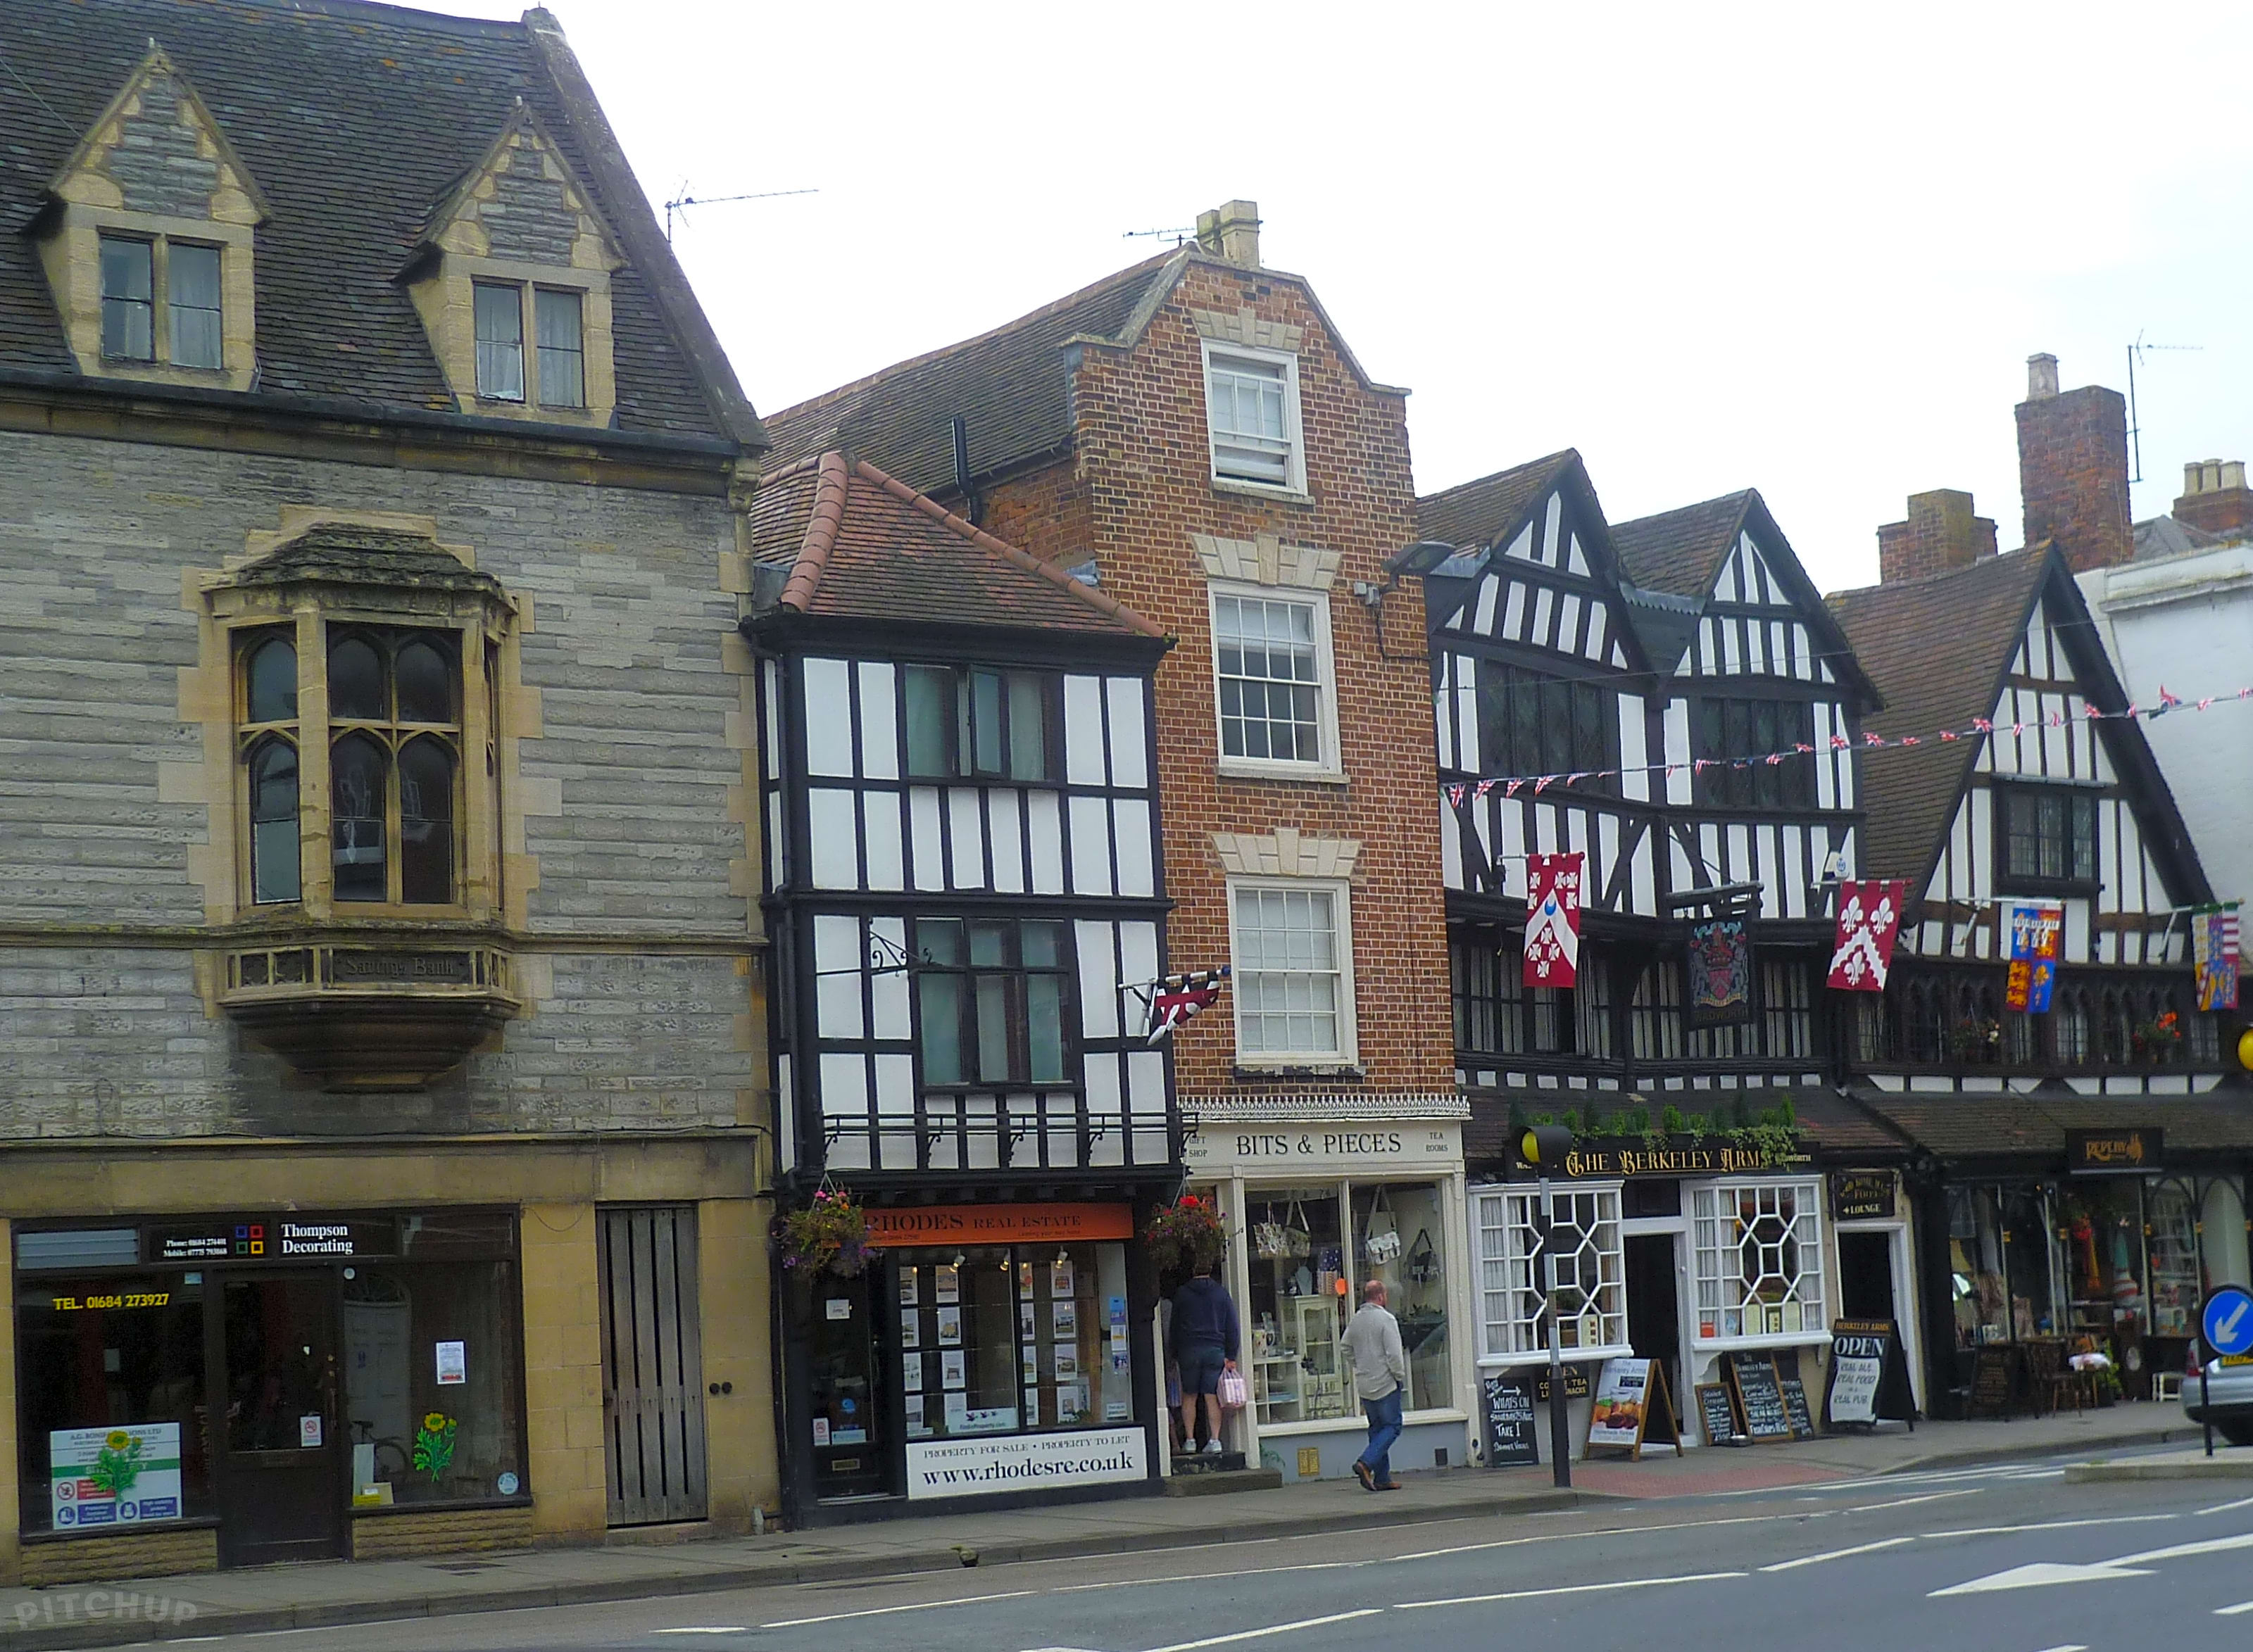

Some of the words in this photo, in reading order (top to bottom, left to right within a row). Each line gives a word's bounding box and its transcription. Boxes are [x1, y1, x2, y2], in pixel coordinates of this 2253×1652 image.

[1189, 1136, 1205, 1145] GIFT
[1429, 1131, 1443, 1140] TEA
[1236, 1134, 1288, 1156] BITS
[1298, 1135, 1314, 1154] &
[1323, 1133, 1401, 1154] PIECES
[1426, 1144, 1448, 1153] ROOMS
[1189, 1149, 1207, 1158] SHOP
[1565, 1150, 1610, 1178] THE
[1619, 1149, 1713, 1175] BERKELEY
[1850, 1203, 1881, 1214] LOUNGE
[863, 1214, 964, 1232] RHODES
[974, 1217, 1016, 1229] REAL
[1022, 1216, 1081, 1228] ESTATE
[282, 1224, 349, 1240] Thompson
[282, 1239, 353, 1254] Decorating
[52, 1297, 83, 1311] TEL.
[87, 1295, 122, 1309] 01684
[125, 1293, 170, 1307] 273927
[1833, 1337, 1885, 1356] OPEN
[1571, 1377, 1587, 1387] TEA
[1519, 1395, 1530, 1408] ON
[1495, 1423, 1514, 1437] TAKE
[924, 1446, 977, 1458] PROPERTY
[979, 1444, 1000, 1455] FOR
[1002, 1442, 1029, 1453] SALE
[1041, 1439, 1092, 1450] PROPERTY
[1093, 1437, 1109, 1446] TO
[1110, 1435, 1131, 1444] LET
[922, 1450, 1134, 1485] www.rhodesre.co.uk
